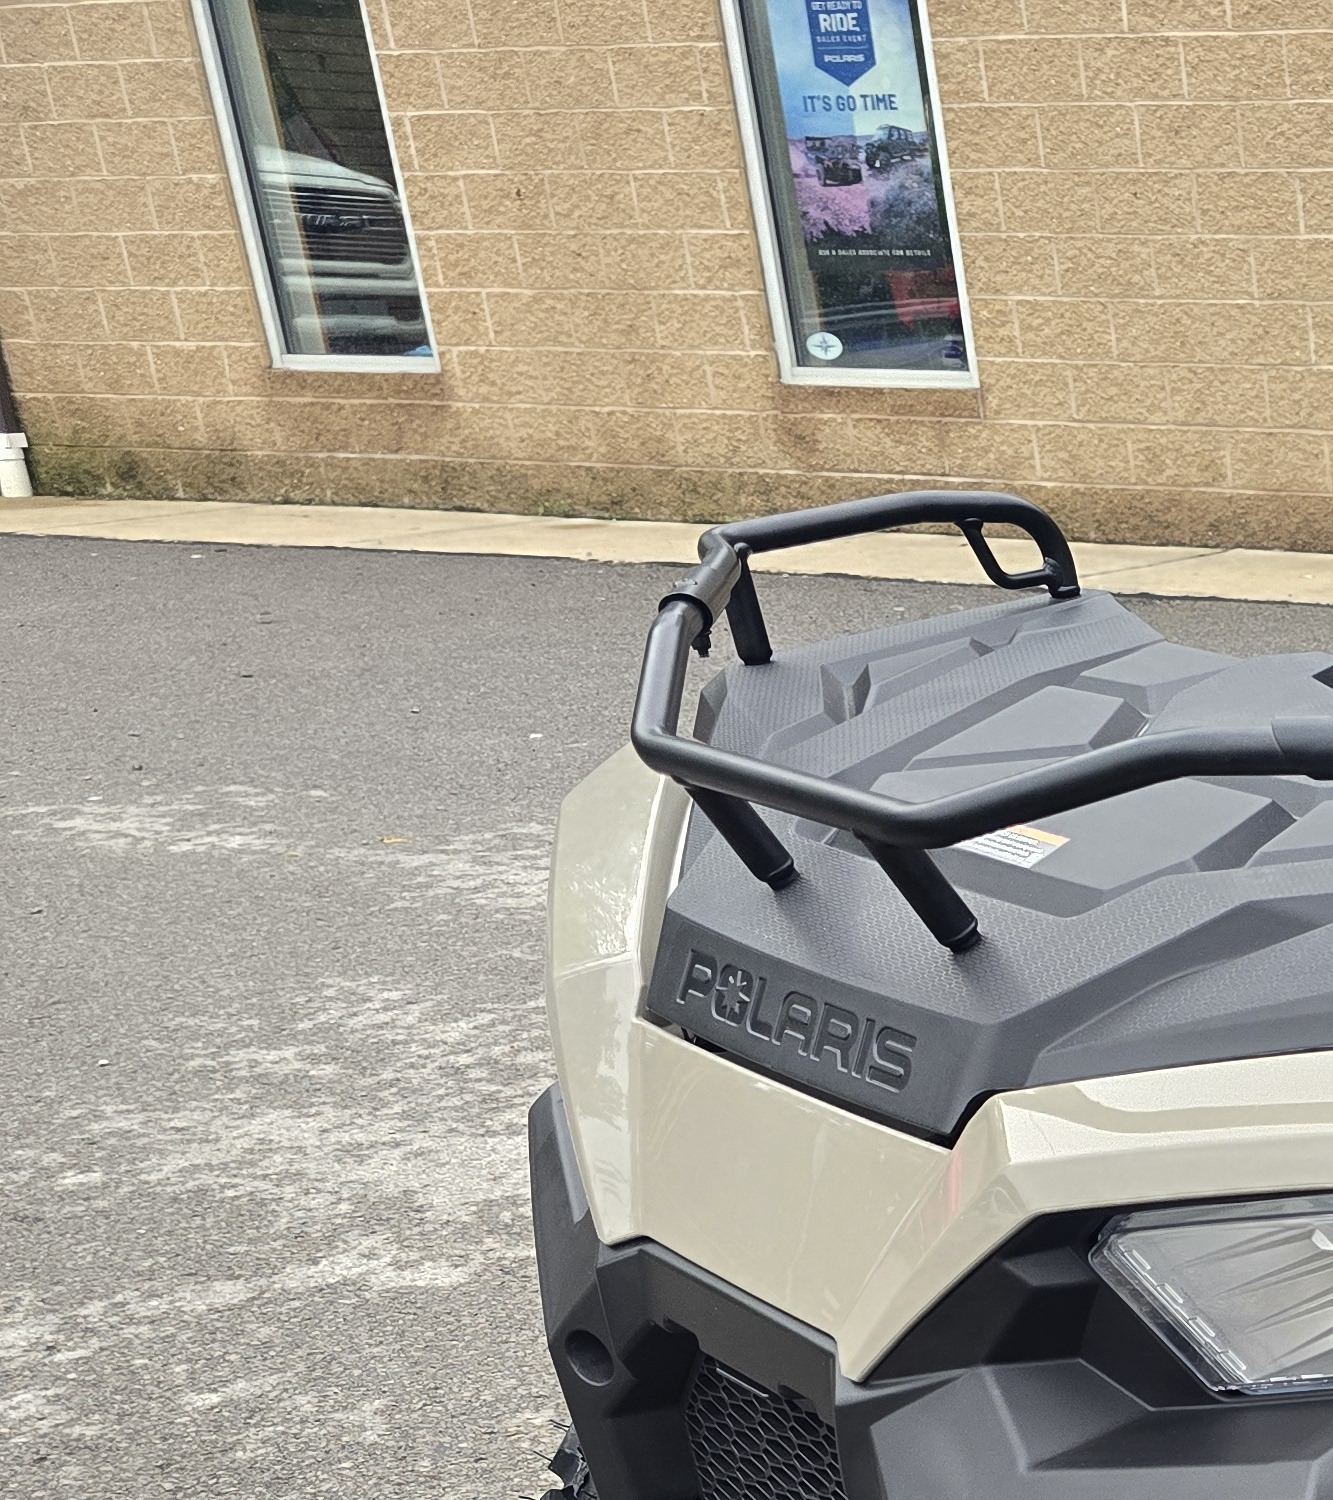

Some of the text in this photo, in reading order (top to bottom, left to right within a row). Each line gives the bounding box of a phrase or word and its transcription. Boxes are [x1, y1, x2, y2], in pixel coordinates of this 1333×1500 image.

[818, 12, 860, 32] RIDE
[802, 94, 898, 112] IT'S GO TIME
[677, 949, 917, 1093] POLARIS
